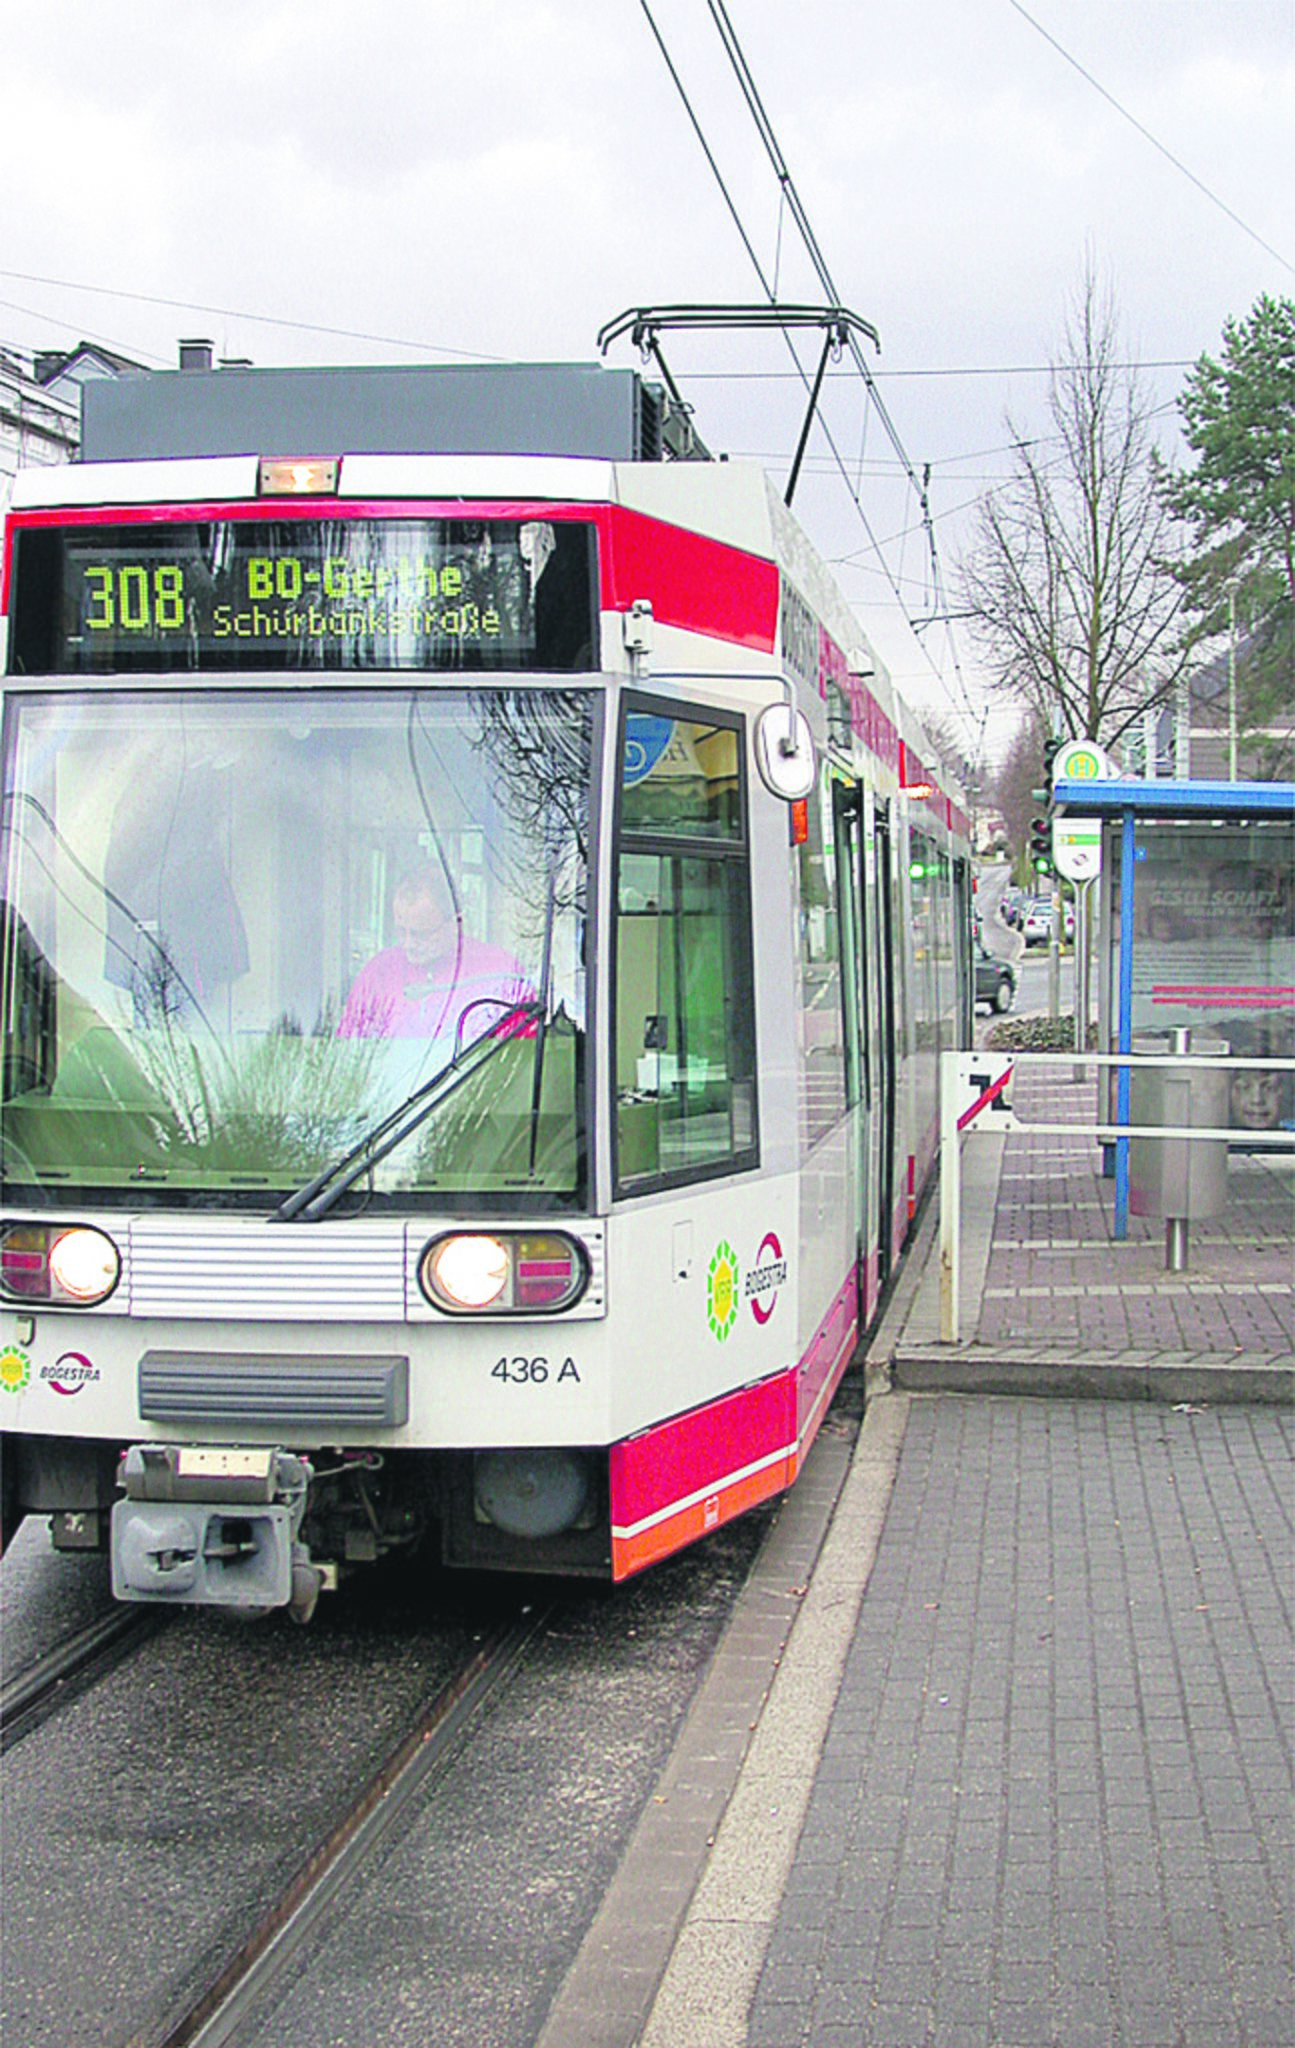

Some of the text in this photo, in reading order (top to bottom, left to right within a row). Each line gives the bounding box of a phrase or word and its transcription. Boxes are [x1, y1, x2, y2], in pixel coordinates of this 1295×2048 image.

[249, 557, 462, 598] BO-Gerthe
[84, 566, 184, 628] 308
[745, 1261, 787, 1296] BOGESTRA
[40, 1365, 101, 1381] BOGESTRA
[490, 1356, 581, 1383] 436 A
